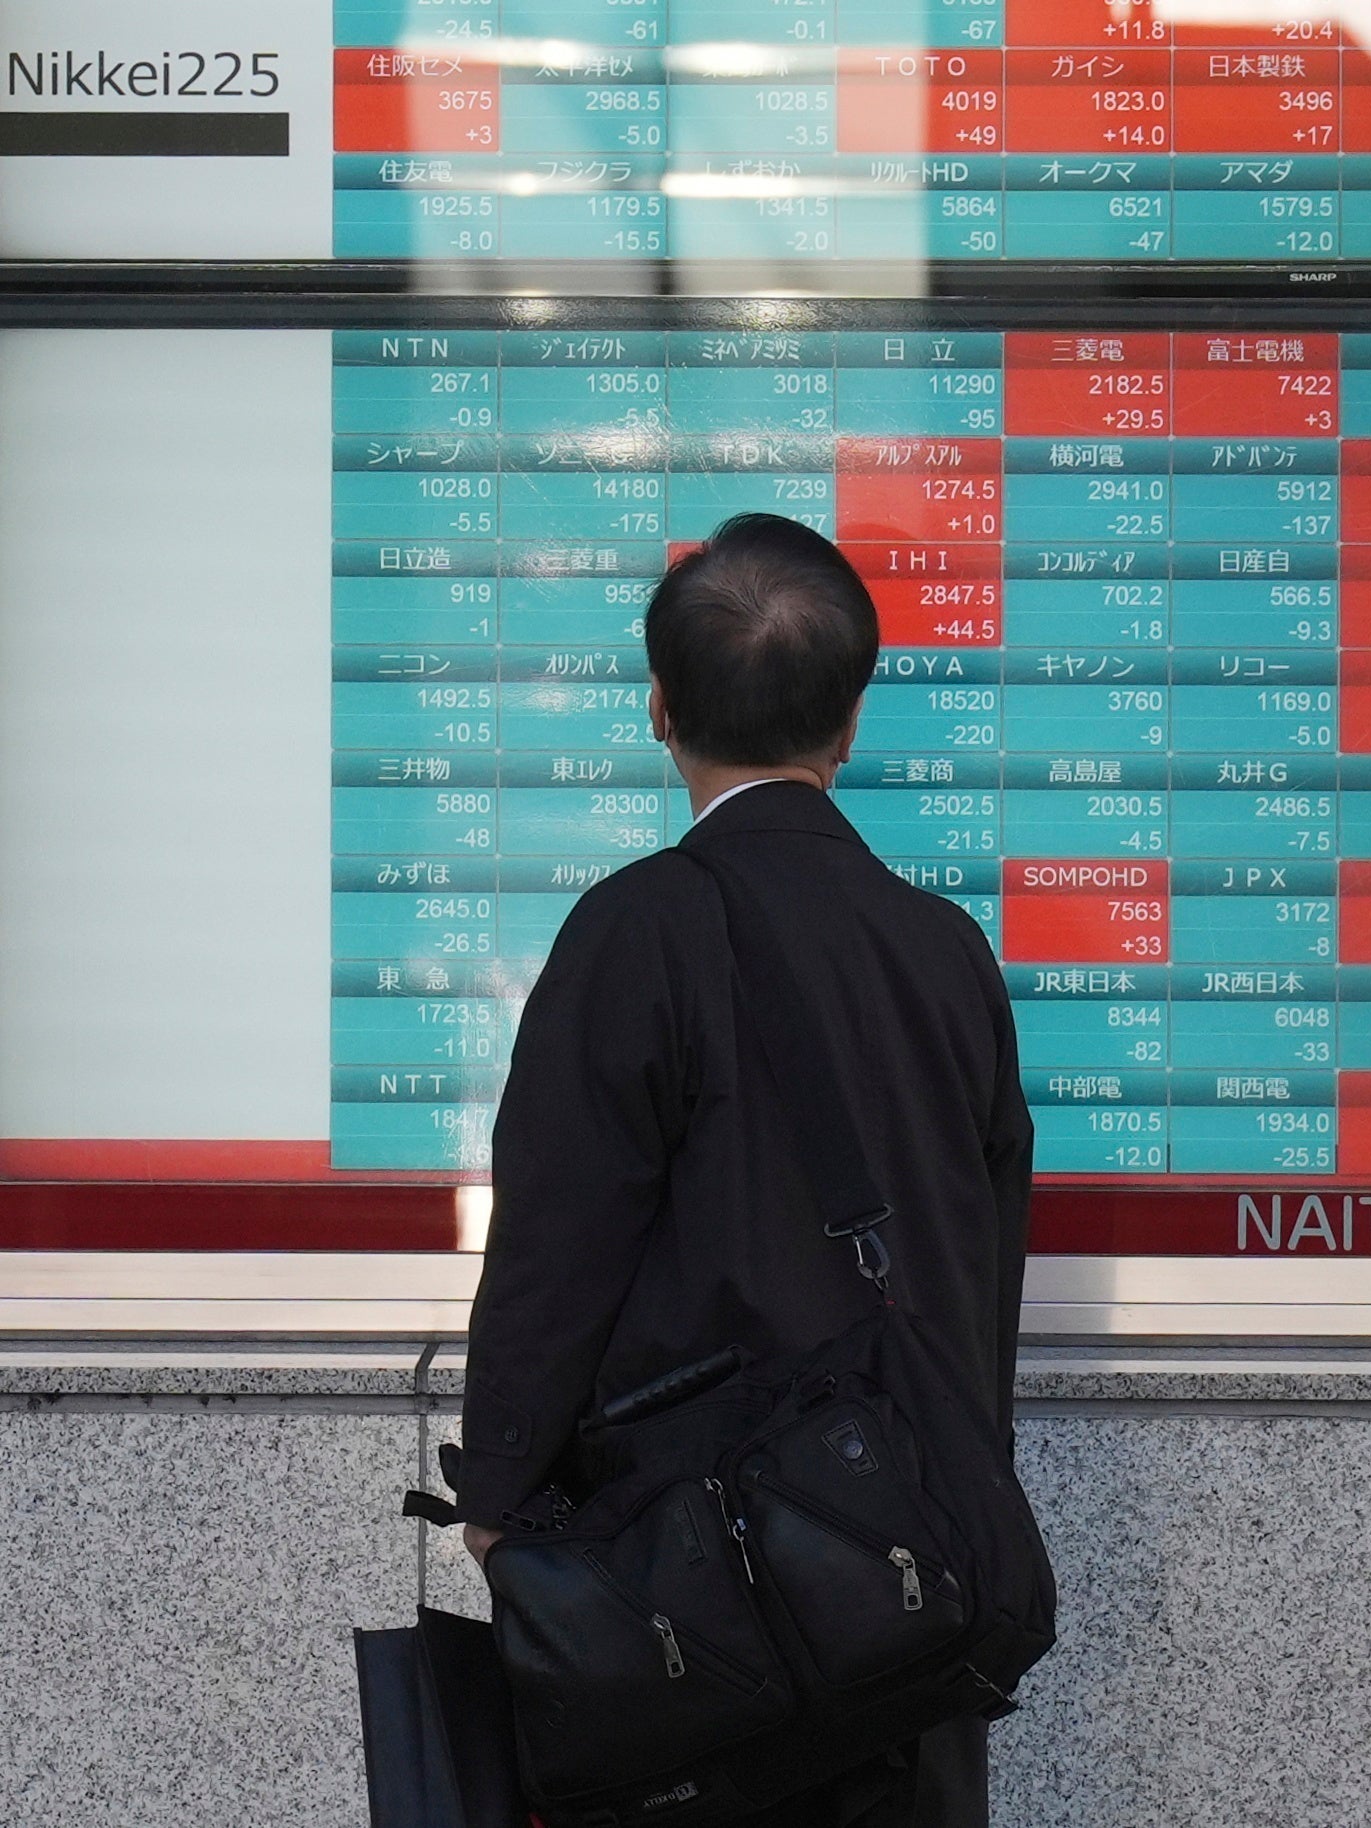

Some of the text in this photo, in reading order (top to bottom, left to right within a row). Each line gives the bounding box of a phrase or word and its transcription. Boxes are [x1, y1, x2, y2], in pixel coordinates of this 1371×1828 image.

[436, 19, 493, 39] -24.5
[1103, 20, 1165, 40] +11.8
[1271, 20, 1333, 40] +20.4
[8, 50, 280, 97] Nikkei225
[366, 53, 463, 78] 住阪セメ
[1051, 54, 1125, 78] ガイシ
[1209, 54, 1306, 78] 日本製鉄
[941, 90, 997, 111] 4019
[1091, 90, 1165, 112] 1823.0
[1279, 90, 1333, 111] 3496
[378, 159, 453, 183] 住友電
[1039, 159, 1137, 184] オークマ
[1220, 159, 1294, 184] アマダ
[941, 195, 997, 217] 5864
[1108, 196, 1162, 218] 6521
[1259, 196, 1333, 217] 1579.5
[1289, 272, 1337, 282] SHARP
[1051, 337, 1125, 362] 三菱電
[1206, 337, 1305, 363] 富士電機
[430, 372, 489, 393] 267.1
[773, 373, 828, 394] 3018
[1088, 374, 1164, 395] 2182.5
[367, 439, 469, 465] シャープ
[1048, 443, 1125, 468] 横河電
[922, 479, 995, 500] 1274.5
[1277, 480, 1332, 502] 5912
[1106, 514, 1165, 537] -22.5
[380, 546, 452, 571] 日立造
[1219, 548, 1290, 573] 日産自
[1101, 585, 1163, 606] 702.2
[932, 619, 995, 640] +44.5
[377, 653, 451, 676] ニコン
[1036, 653, 1135, 678] キヤノン
[1220, 655, 1290, 677] リコー
[927, 689, 995, 711] 18520
[1257, 691, 1332, 712] 1169.0
[377, 756, 451, 783] 三井物
[881, 758, 955, 784] 三菱商
[1049, 757, 1122, 783] 高島屋
[1216, 759, 1288, 784] 丸井G
[436, 793, 491, 814] 5880
[1086, 795, 1163, 817] 2030.5
[377, 860, 451, 886] みずほ
[1023, 866, 1148, 887] SOMPOHD
[1274, 896, 1330, 923] 3172
[434, 932, 491, 954] -26.5
[1033, 968, 1136, 995] JR東日本
[1201, 970, 1305, 994] JR西日本
[1049, 1074, 1123, 1099] 中部電
[1216, 1076, 1291, 1100] 関西電
[1256, 1111, 1330, 1133] 1934.0
